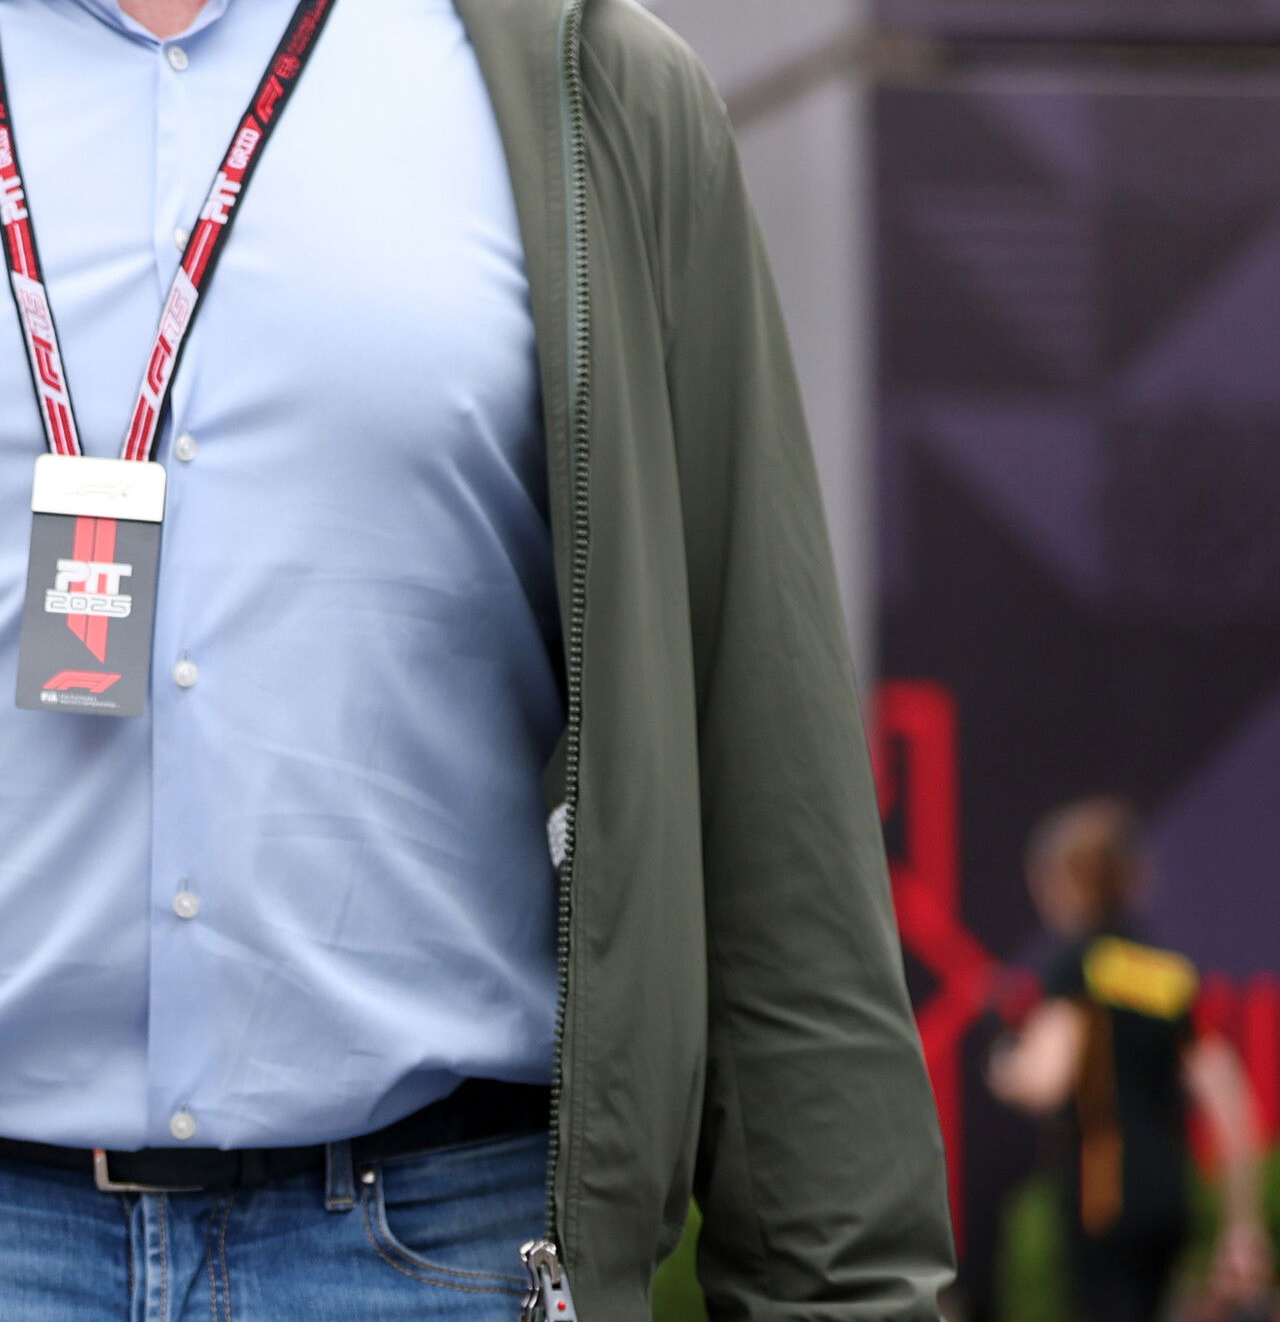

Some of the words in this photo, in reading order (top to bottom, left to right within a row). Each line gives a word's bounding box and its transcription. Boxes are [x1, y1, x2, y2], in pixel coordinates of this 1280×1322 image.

[200, 171, 241, 225] PIT
[55, 558, 132, 594] PIT
[44, 590, 131, 617] 2025
